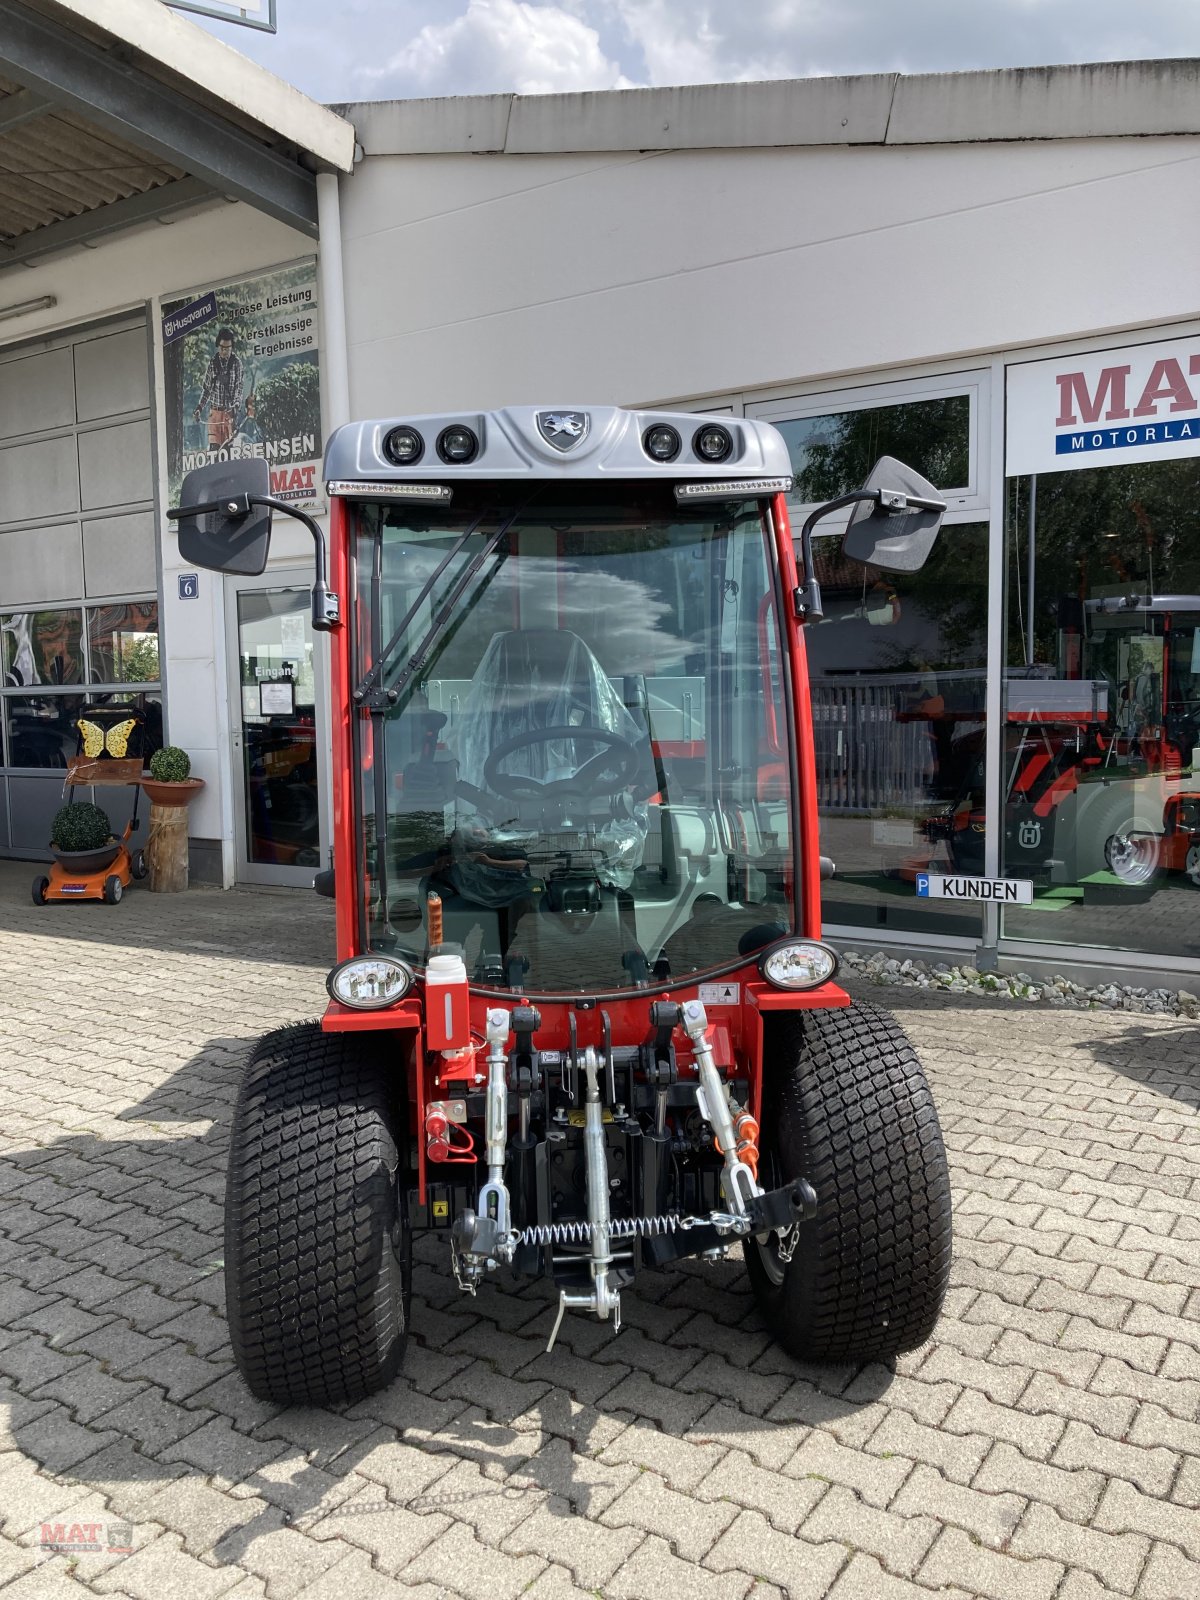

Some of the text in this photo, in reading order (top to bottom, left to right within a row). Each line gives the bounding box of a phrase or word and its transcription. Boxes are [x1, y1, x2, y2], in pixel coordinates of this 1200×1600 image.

[173, 303, 212, 331] Husqvarna
[228, 289, 312, 321] grosse Leistung
[247, 318, 312, 341] erstklassige
[253, 335, 313, 357] Ergebnisse
[1056, 354, 1200, 427] MA
[181, 434, 315, 472] MOTORSENSEN
[271, 465, 316, 492] MAT
[184, 581, 192, 596] 6
[255, 665, 298, 680] Eingang
[918, 879, 1017, 901] P KUNDEN
